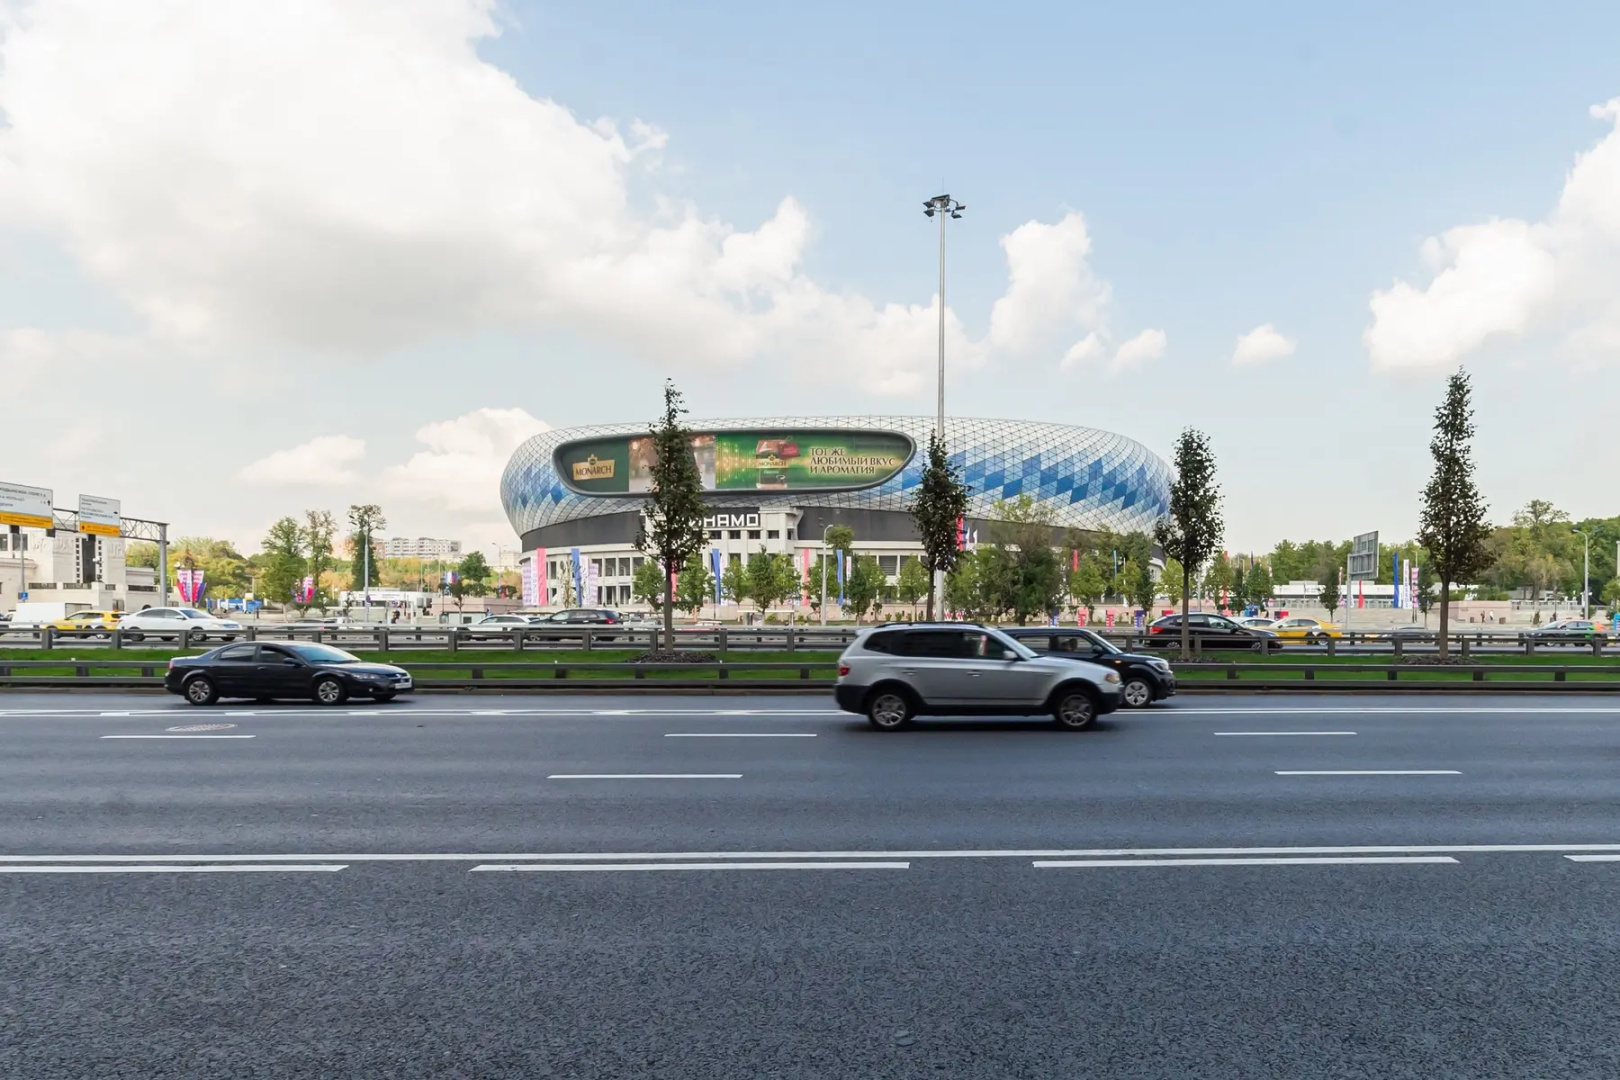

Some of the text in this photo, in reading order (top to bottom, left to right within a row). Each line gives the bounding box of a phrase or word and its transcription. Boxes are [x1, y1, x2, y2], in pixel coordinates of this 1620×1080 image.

[810, 447, 845, 456] ТОТ ЖЕ
[810, 457, 896, 467] ЛЮБИМЫЙ ВКУС
[575, 465, 612, 476] MONARCH
[810, 466, 875, 475] И АРОМАГИЯ
